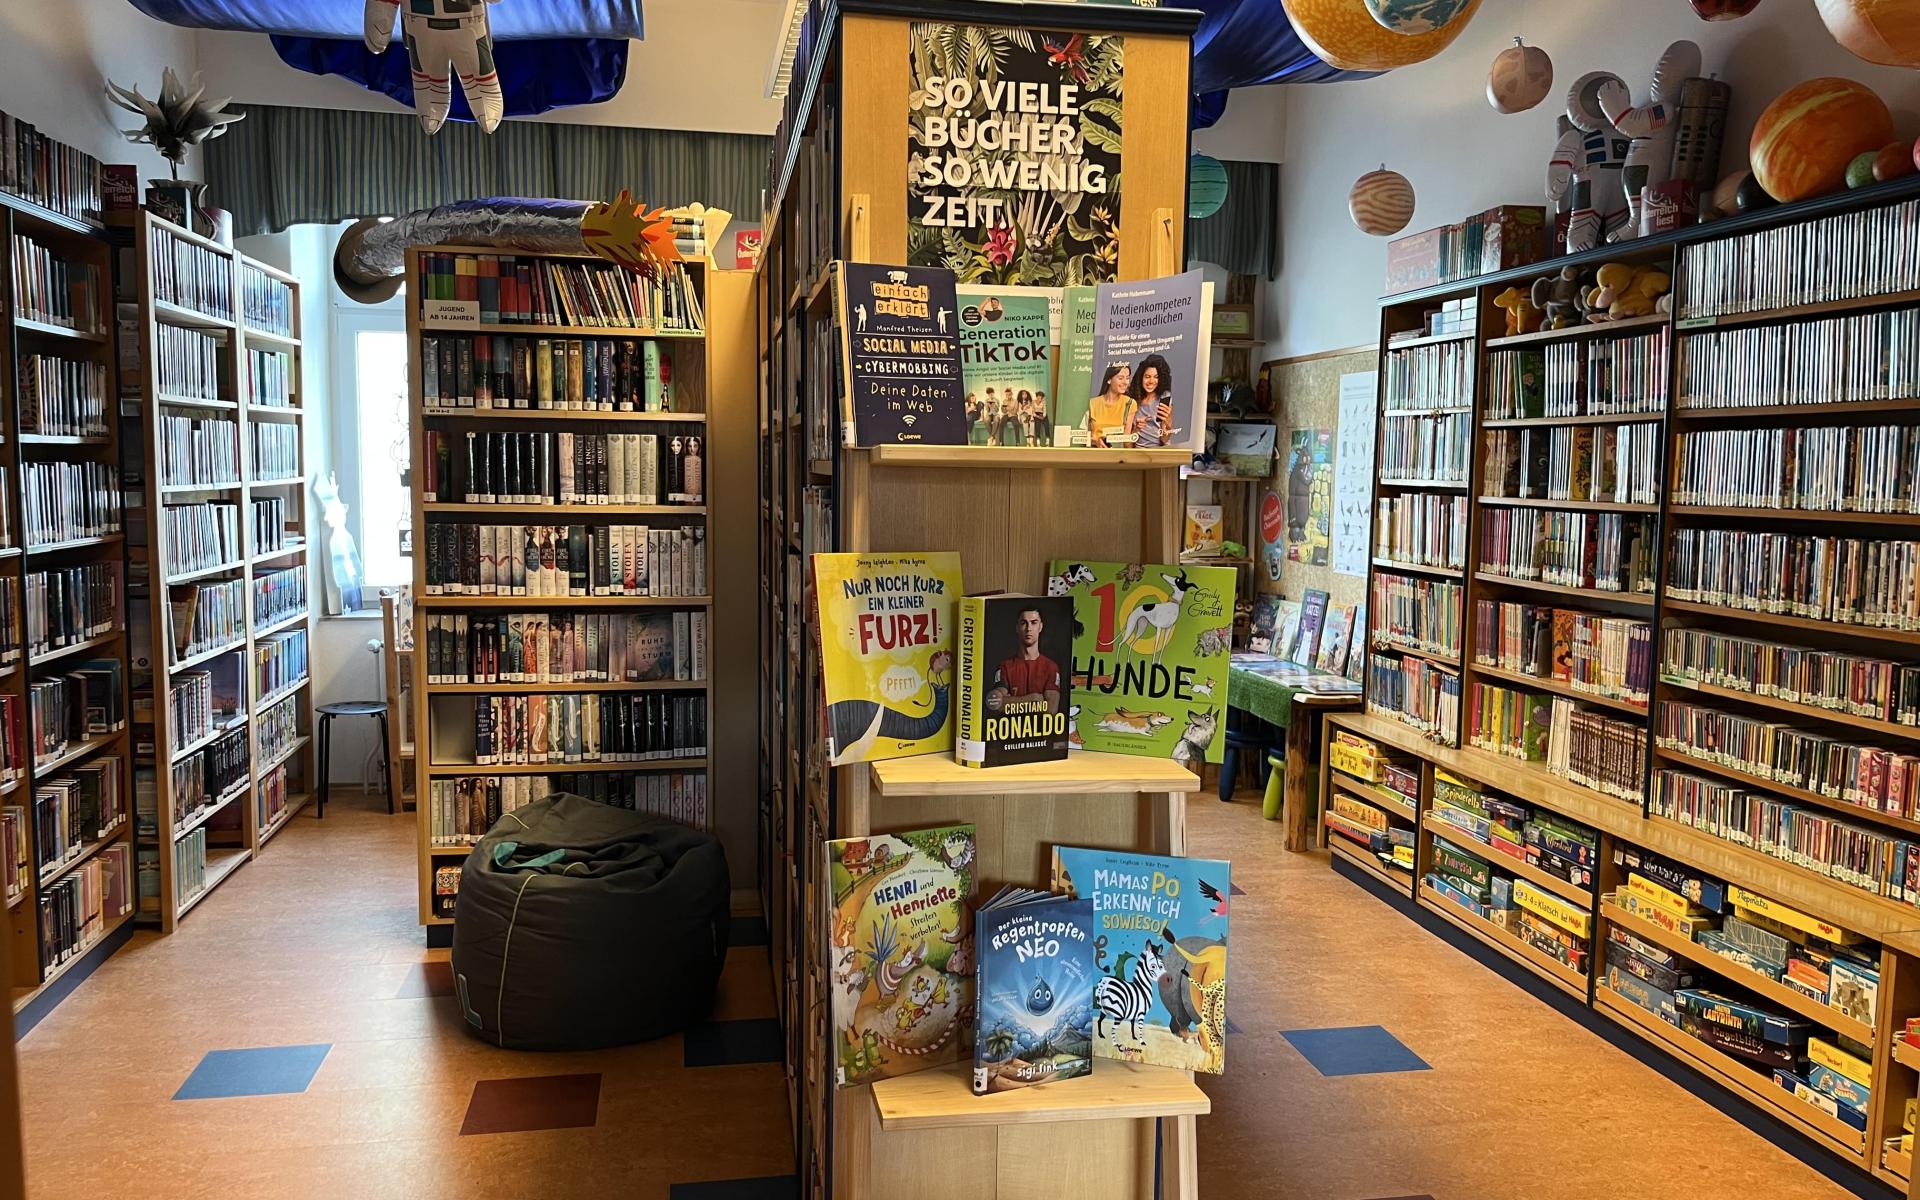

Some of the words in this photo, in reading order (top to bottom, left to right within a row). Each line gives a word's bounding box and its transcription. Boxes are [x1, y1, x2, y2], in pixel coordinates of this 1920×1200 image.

[924, 78, 973, 109] SO
[981, 80, 1079, 115] VIELE
[924, 157, 972, 188] SO
[980, 160, 1107, 193] WENIG
[922, 196, 1007, 229] ZEIT.
[875, 285, 928, 299] einfach
[877, 301, 926, 316] erklärt
[1110, 296, 1192, 316] Medienkompetenz
[876, 325, 904, 333] Manfred
[907, 325, 933, 333] Theisen
[1076, 322, 1091, 334] bei
[1109, 318, 1124, 330] bei
[1125, 312, 1183, 331] Jugendlichen
[959, 326, 1047, 341] Generation
[863, 338, 908, 353] SOCIAL
[911, 339, 948, 355] MEDIA
[960, 341, 1048, 363] TikTok
[865, 360, 949, 375] CYBERMOBBING
[871, 382, 907, 397] Deine
[912, 384, 948, 399] Daten
[888, 398, 901, 410] im
[906, 399, 933, 413] Web
[843, 579, 872, 599] NUR
[875, 575, 910, 593] NOCH
[913, 574, 945, 595] KURZ
[1193, 587, 1221, 608] Emily
[1091, 582, 1177, 655] 10
[1187, 603, 1224, 618] Gravett
[858, 608, 938, 655] FURZ!
[963, 617, 974, 681] CRISTIANO
[1071, 656, 1196, 700] HUNDE
[961, 685, 972, 741] RONALDO
[1004, 700, 1048, 715] CRISTIANO
[986, 712, 1065, 742] RONALDO
[1004, 742, 1026, 751] GUILLEM
[1026, 740, 1047, 750] BALAGUÉ
[1445, 787, 1480, 809] Spinderella
[874, 879, 917, 906] HENRI
[920, 876, 934, 891] und
[1094, 869, 1149, 890] MAMAS
[1151, 871, 1180, 897] PO
[890, 886, 956, 920] Henriette
[1538, 900, 1559, 918] Klatsch
[910, 911, 937, 928] Streiten
[1011, 914, 1033, 924] kleine
[910, 920, 941, 940] verboten!
[991, 920, 1085, 951] Regentropfen
[1015, 936, 1060, 963] NEO
[1703, 1008, 1742, 1030] LABYRINTH
[1017, 1064, 1036, 1079] sigi
